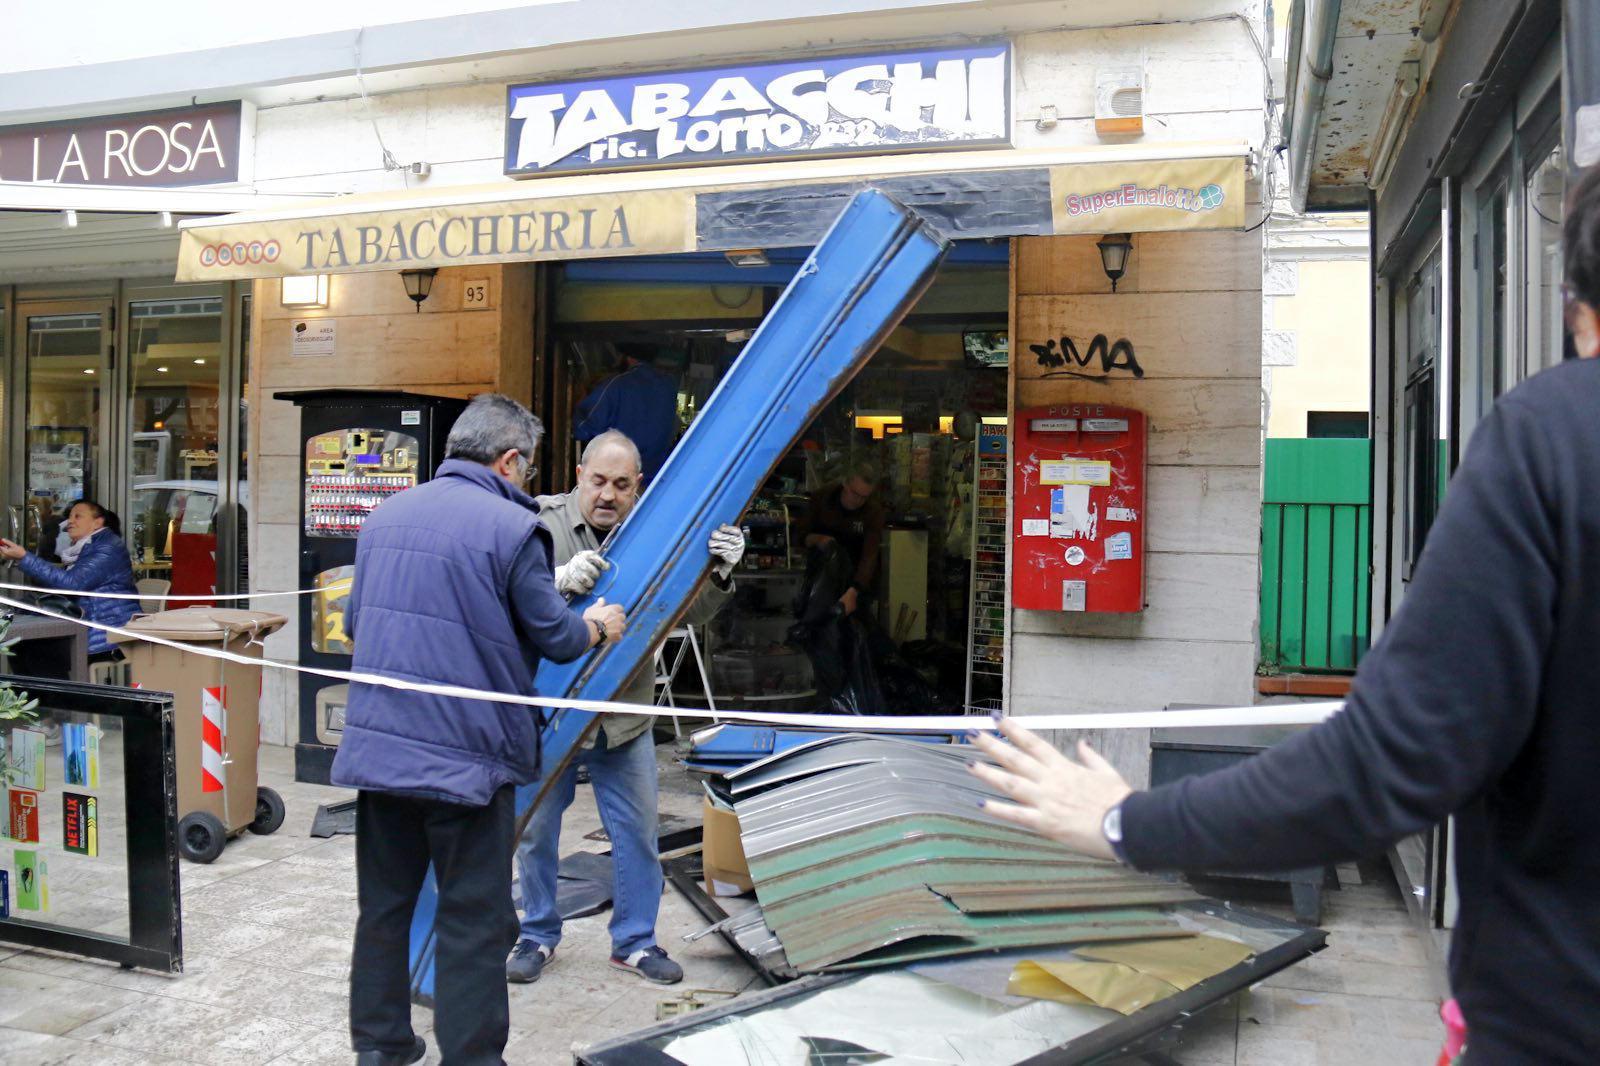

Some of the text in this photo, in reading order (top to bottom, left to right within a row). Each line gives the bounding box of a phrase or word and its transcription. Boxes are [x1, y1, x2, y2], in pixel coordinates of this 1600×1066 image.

[510, 52, 1007, 169] TABACCHI
[32, 119, 225, 183] LA ROSA
[1064, 184, 1203, 216] SuperEnalotto
[296, 204, 636, 271] TABACCHERIA
[467, 287, 484, 302] 93
[1049, 406, 1104, 416] POSTE
[67, 798, 78, 847] NETFLIX
